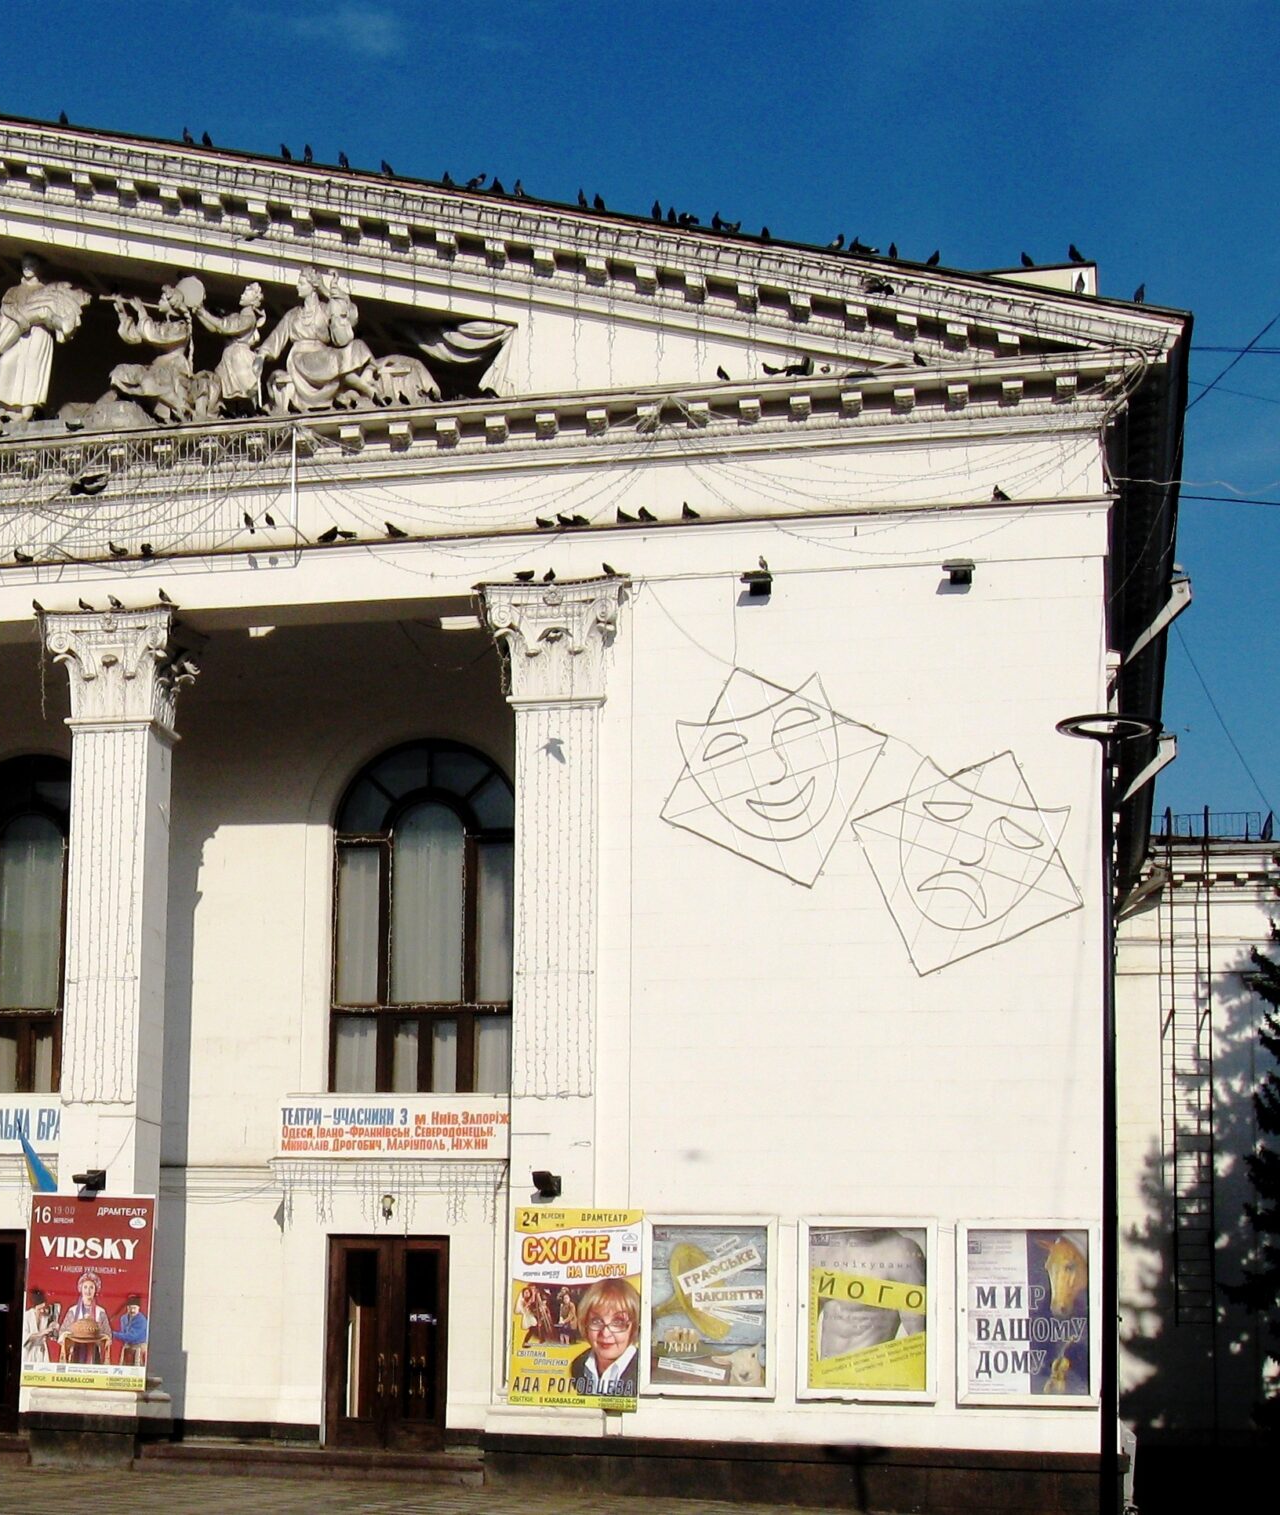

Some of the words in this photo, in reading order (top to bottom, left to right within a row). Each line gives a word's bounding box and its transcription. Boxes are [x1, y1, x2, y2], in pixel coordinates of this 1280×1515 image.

[34, 1205, 52, 1224] 16
[97, 1206, 148, 1217] ДРАМТЕАТР
[522, 1211, 539, 1227] 24
[581, 1213, 628, 1222] ДРАМТЕАТР
[39, 1236, 140, 1260] VIRSKY
[522, 1235, 611, 1265] СХОЖЕ
[566, 1265, 584, 1279] НА
[586, 1263, 627, 1279] ЩАСТЯ
[683, 1248, 757, 1288] ГРАФСЬКЕ
[694, 1289, 764, 1303] ЗАКЛЯТТЯ
[818, 1271, 924, 1309] ЙОГО
[976, 1285, 1045, 1310] МИР
[976, 1317, 1087, 1343] ВАШОМУ
[975, 1349, 1047, 1379] ДОМУ
[513, 1376, 540, 1392] АДА
[548, 1377, 633, 1396] РОГОВЦЕВА
